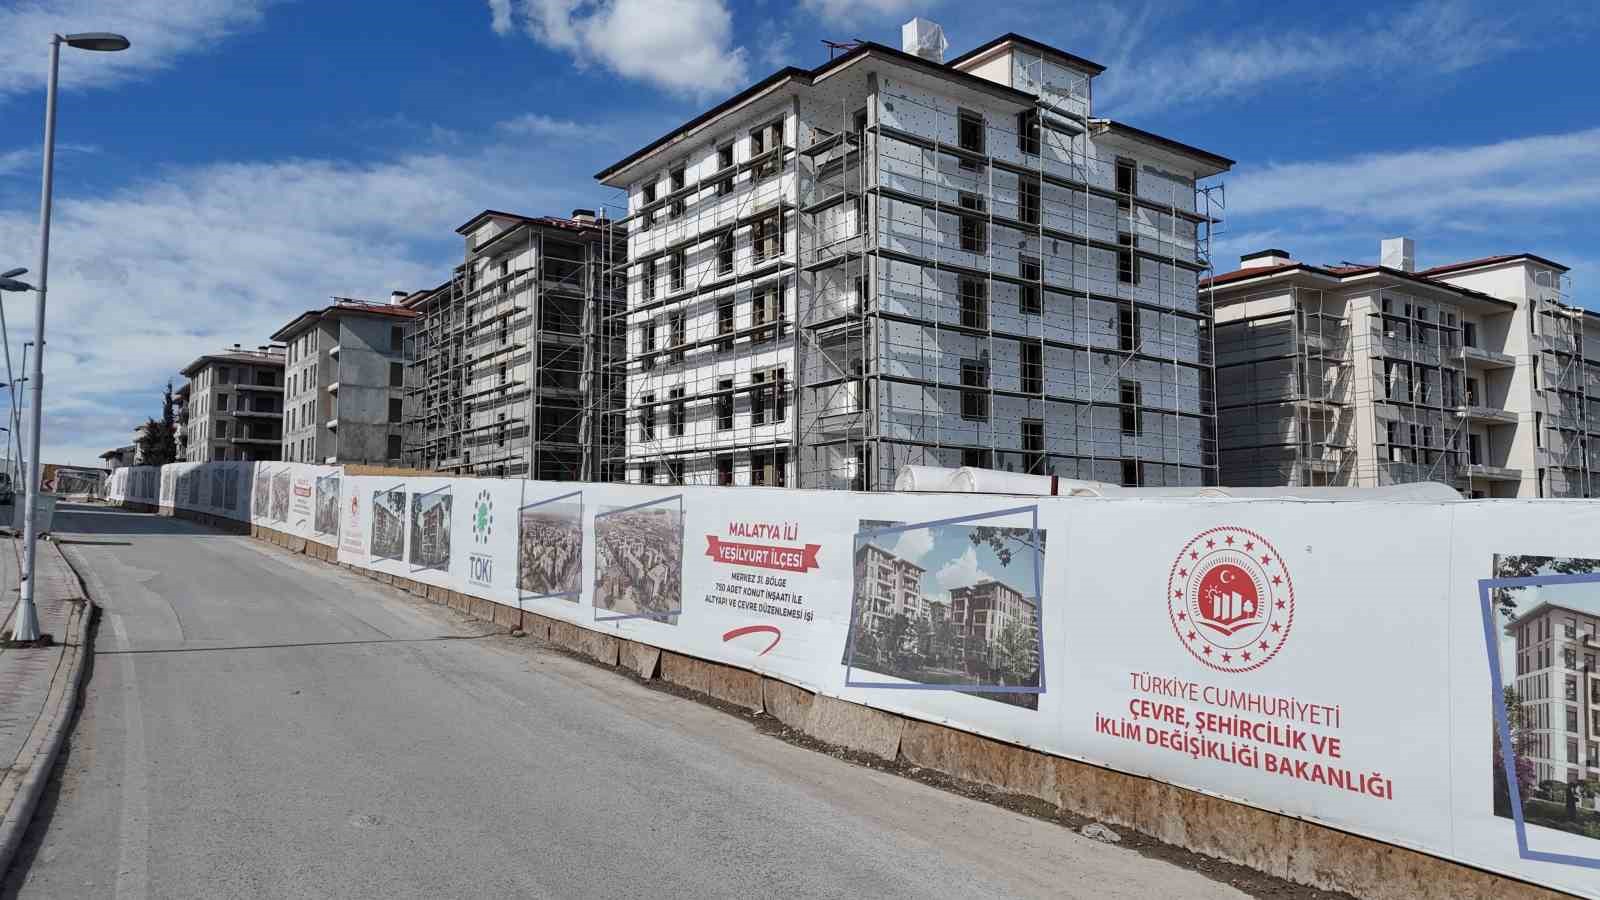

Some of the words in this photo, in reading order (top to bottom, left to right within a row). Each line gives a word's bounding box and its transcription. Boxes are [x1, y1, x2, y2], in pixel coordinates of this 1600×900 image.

[729, 522, 779, 540] MALATYA
[783, 521, 798, 541] İLİ
[719, 545, 769, 563] YEŞİLYURT
[770, 548, 803, 568] İLÇESİ
[731, 572, 755, 583] MERKEZ
[765, 576, 787, 588] BÖLGE
[705, 593, 728, 606] ALTYAPI
[729, 598, 737, 608] VE
[726, 585, 742, 595] ADET
[743, 587, 765, 598] KONUT
[765, 589, 791, 602] İNŞAATI
[1130, 671, 1199, 702] TÜRKİYE
[1203, 685, 1340, 729] CUMHURİYETİ
[1129, 698, 1190, 729] ÇEVRE,
[1195, 711, 1308, 752] ŞEHİRCİLİK
[1311, 733, 1342, 759] VE
[1095, 711, 1141, 742] İKLİM
[1146, 728, 1259, 769] DEĞİŞİKLİĞİ
[1264, 752, 1393, 801] BAKANLIĞI
